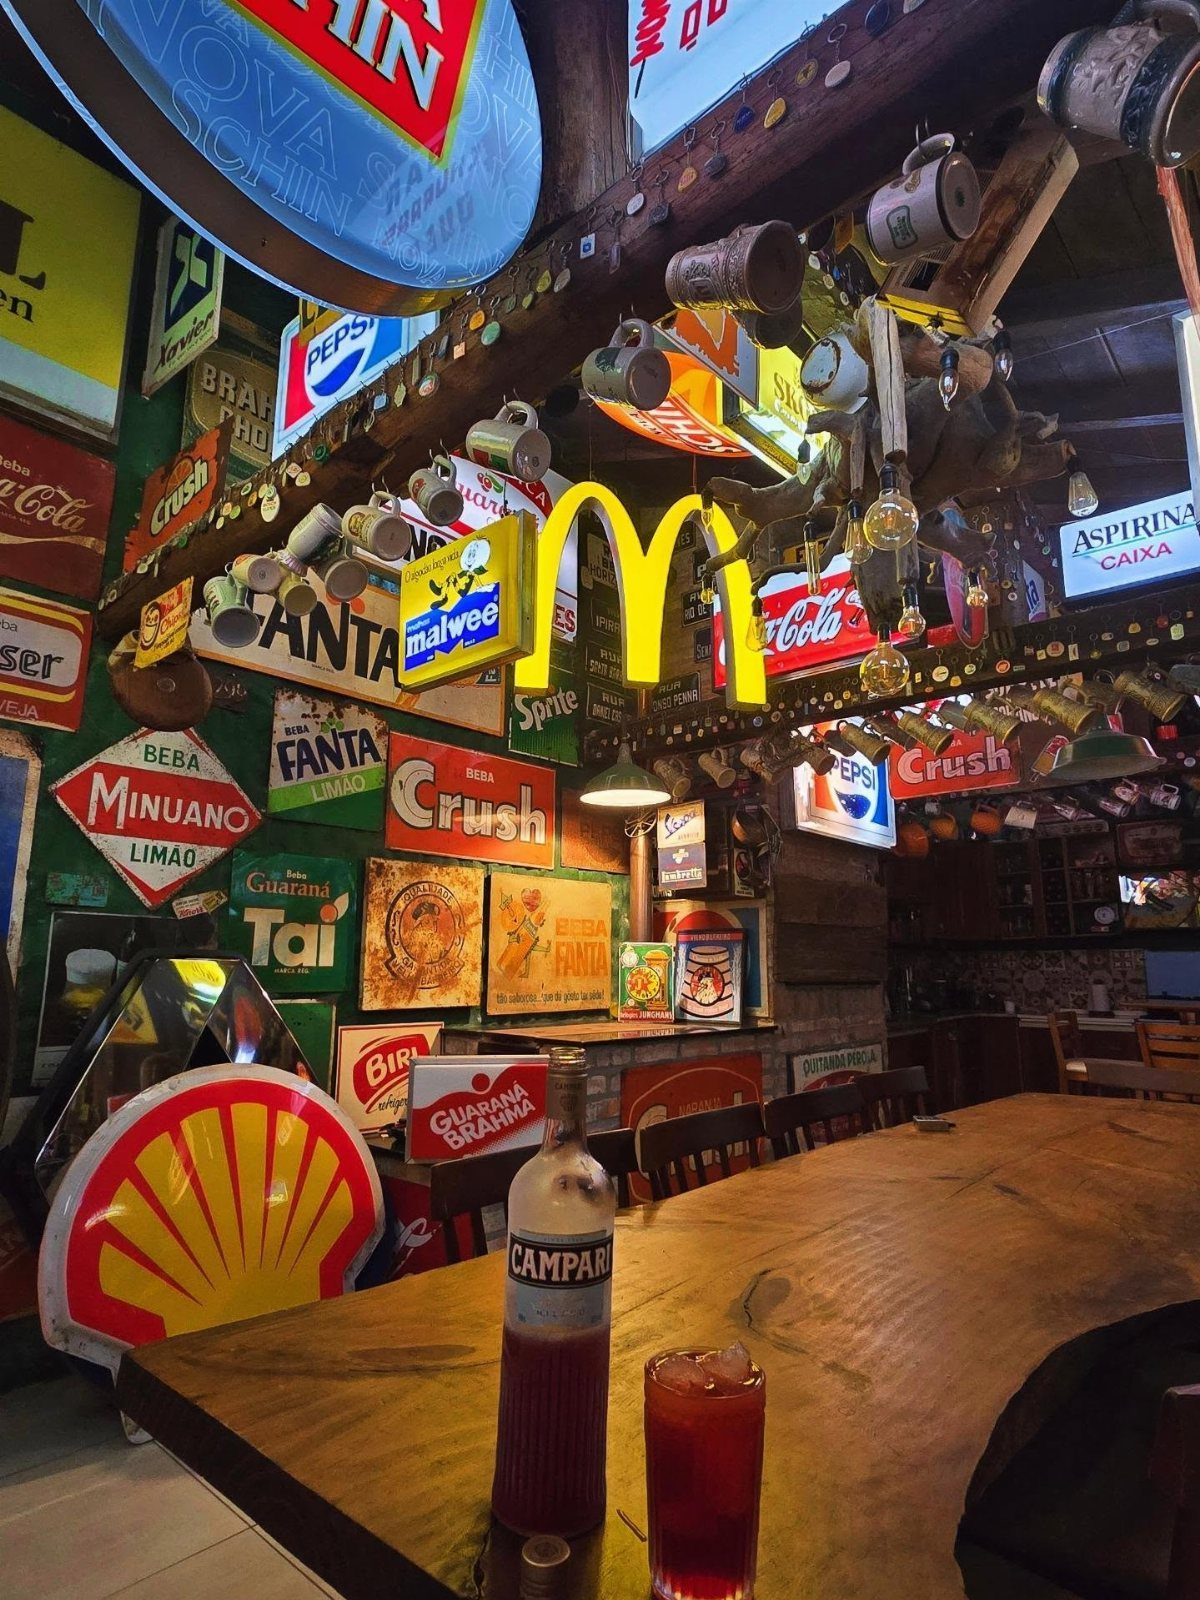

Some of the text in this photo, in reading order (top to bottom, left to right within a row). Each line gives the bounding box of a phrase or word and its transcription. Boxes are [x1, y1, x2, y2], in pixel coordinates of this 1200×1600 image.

[151, 459, 208, 536] Crush
[1101, 542, 1172, 571] CAIXA
[406, 602, 499, 658] malwee
[515, 687, 579, 731] Sprite
[673, 689, 698, 707] PENNA
[285, 725, 310, 736] BEBA
[143, 744, 201, 771] BEBA
[277, 728, 382, 782] FANTA
[897, 736, 1012, 785] Crush
[311, 774, 366, 802] LIMÃO
[466, 767, 495, 784] BEBA
[87, 772, 250, 833] MINUANO
[391, 758, 547, 845] Crush
[130, 843, 196, 868] LIMÃO
[246, 871, 330, 898] Guaraná
[286, 869, 307, 880] Beba
[243, 904, 337, 967] Tai
[556, 917, 608, 938] BEBA
[556, 941, 608, 978] FANTA
[639, 1010, 672, 1019] JUNGHANS
[803, 1053, 846, 1077] QUITANDA
[429, 1080, 529, 1135] GUARANÁ
[442, 1099, 536, 1151] BRAHMA
[511, 1243, 611, 1281] CAMPARI
